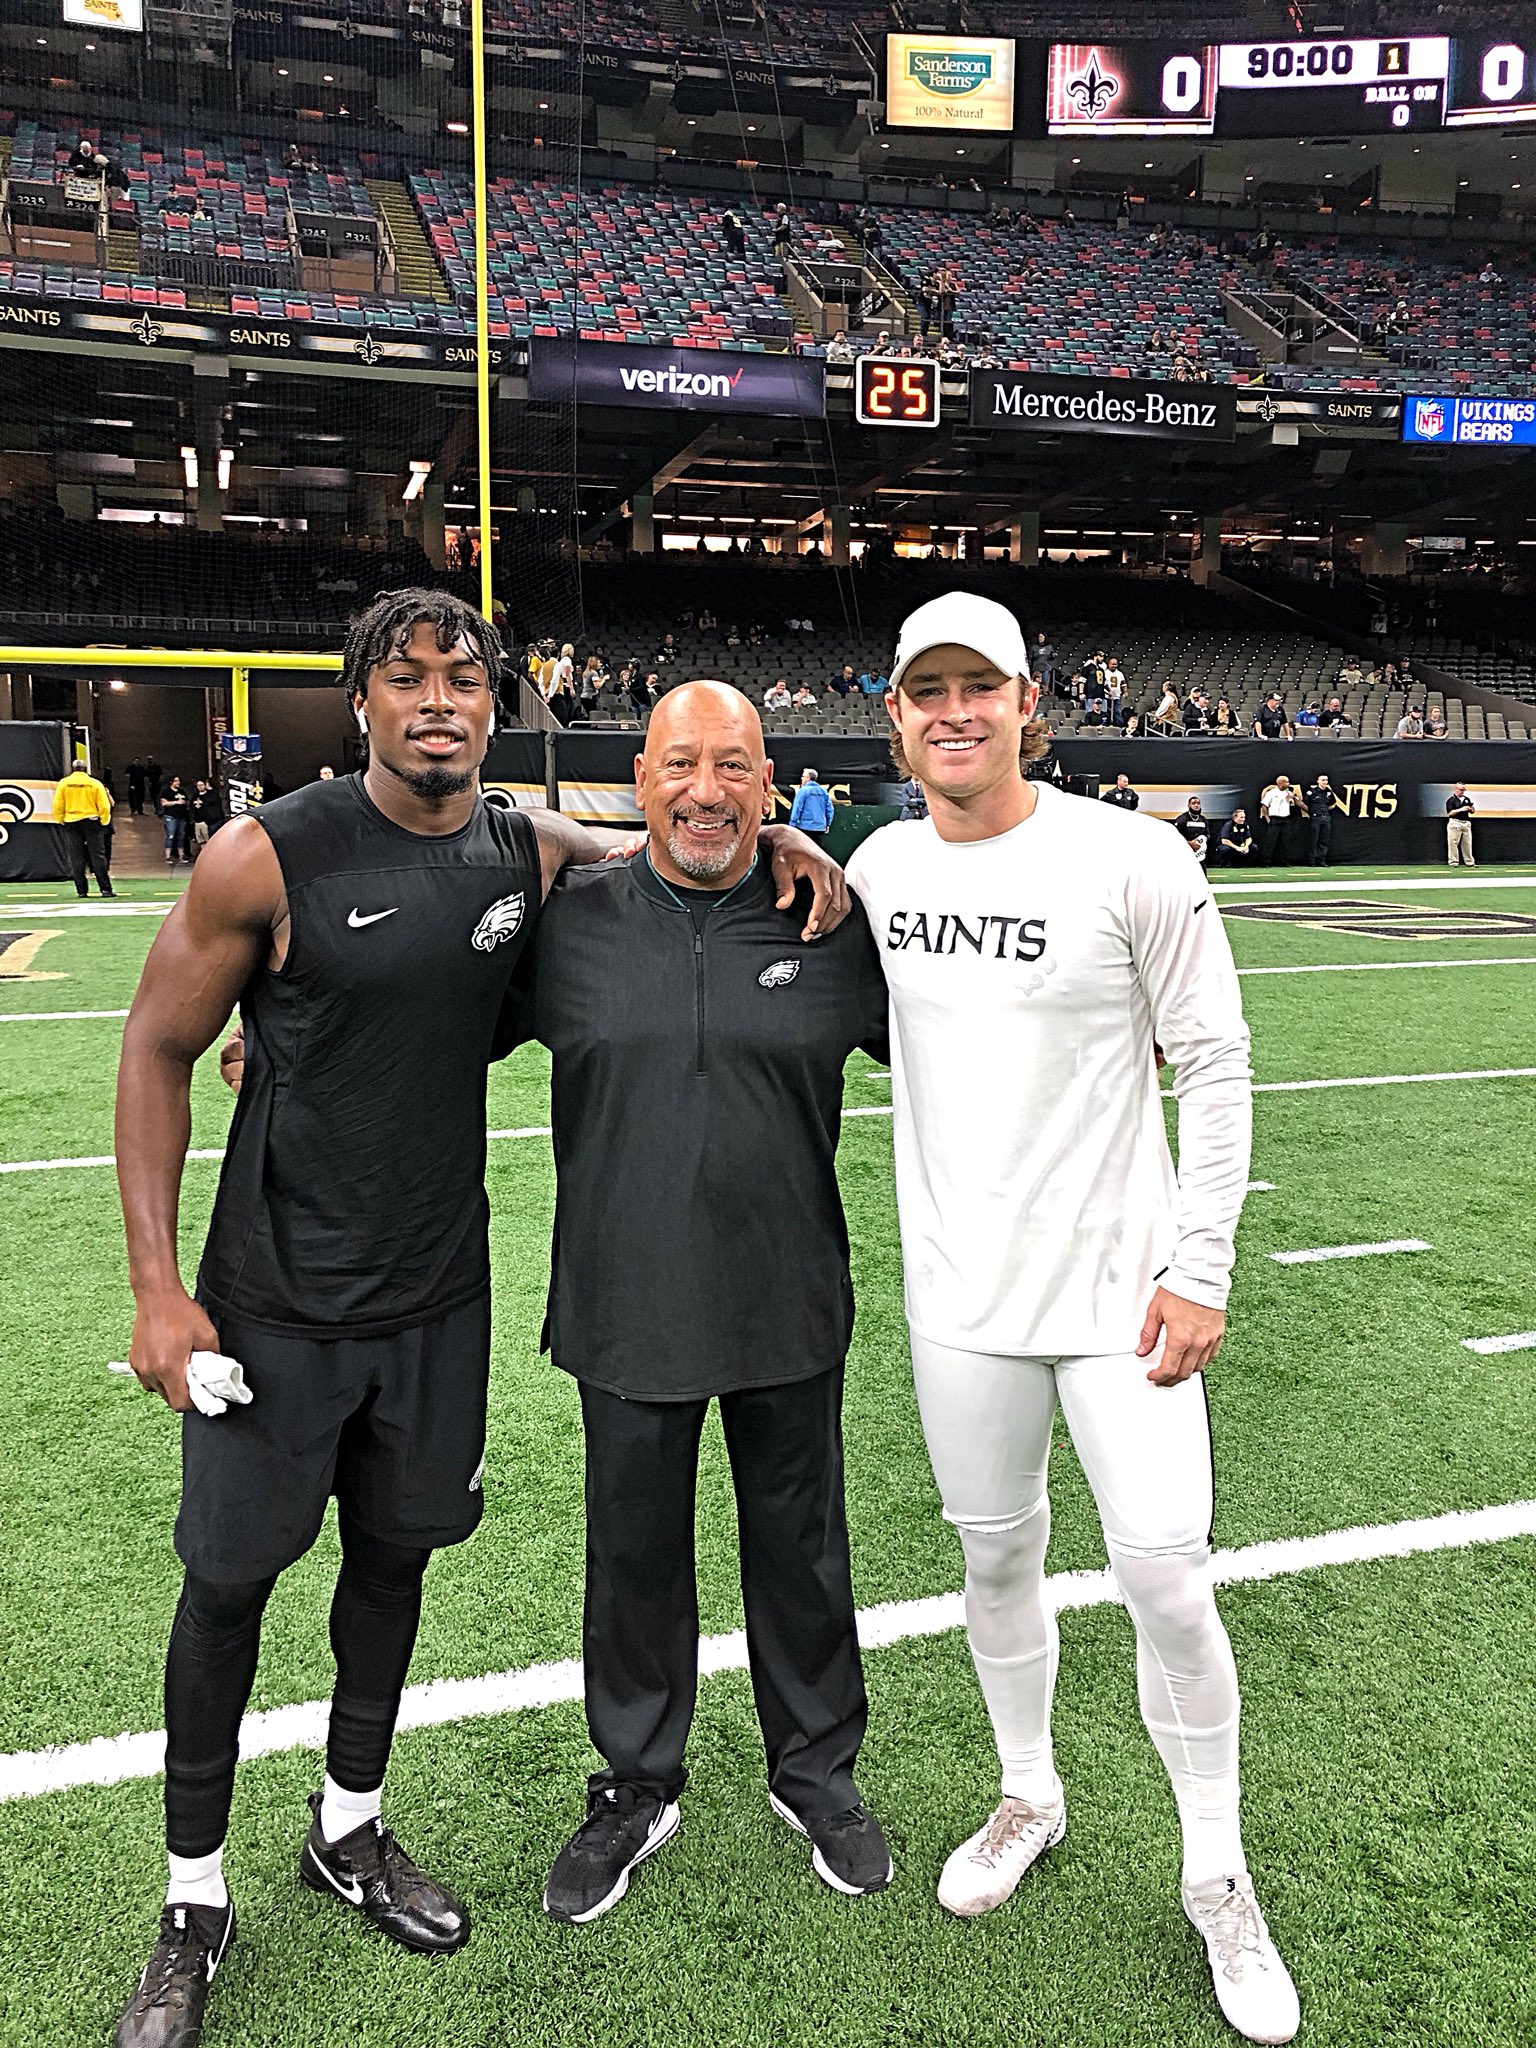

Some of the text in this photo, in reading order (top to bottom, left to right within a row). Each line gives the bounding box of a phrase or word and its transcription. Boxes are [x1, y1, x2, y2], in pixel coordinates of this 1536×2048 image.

[412, 30, 455, 47] SAINTS
[577, 53, 618, 68] SAINTS
[914, 56, 987, 74] Sanderson
[1247, 44, 1353, 79] 90:00
[1387, 47, 1400, 70] 1
[735, 70, 775, 85] SAINTS
[928, 71, 972, 88] Farms
[1482, 44, 1525, 101] 0
[1162, 56, 1201, 112] 0
[1365, 85, 1438, 103] BALL ON
[915, 106, 941, 117] 100%
[945, 107, 984, 119] Natural
[1392, 104, 1410, 127] 0
[841, 278, 856, 286] 326
[0, 305, 61, 326] SAINTS
[229, 329, 291, 347] SAINTS
[445, 347, 502, 364] SAINS
[619, 365, 731, 397] verizon
[869, 366, 927, 416] 25
[992, 384, 1217, 428] Mercedes-Benz
[1327, 402, 1373, 419] SAINTS
[1461, 401, 1536, 422] VIKINGS
[1421, 414, 1444, 433] NFL
[1460, 422, 1514, 441] BEARS
[887, 911, 1047, 962] SAINTS
